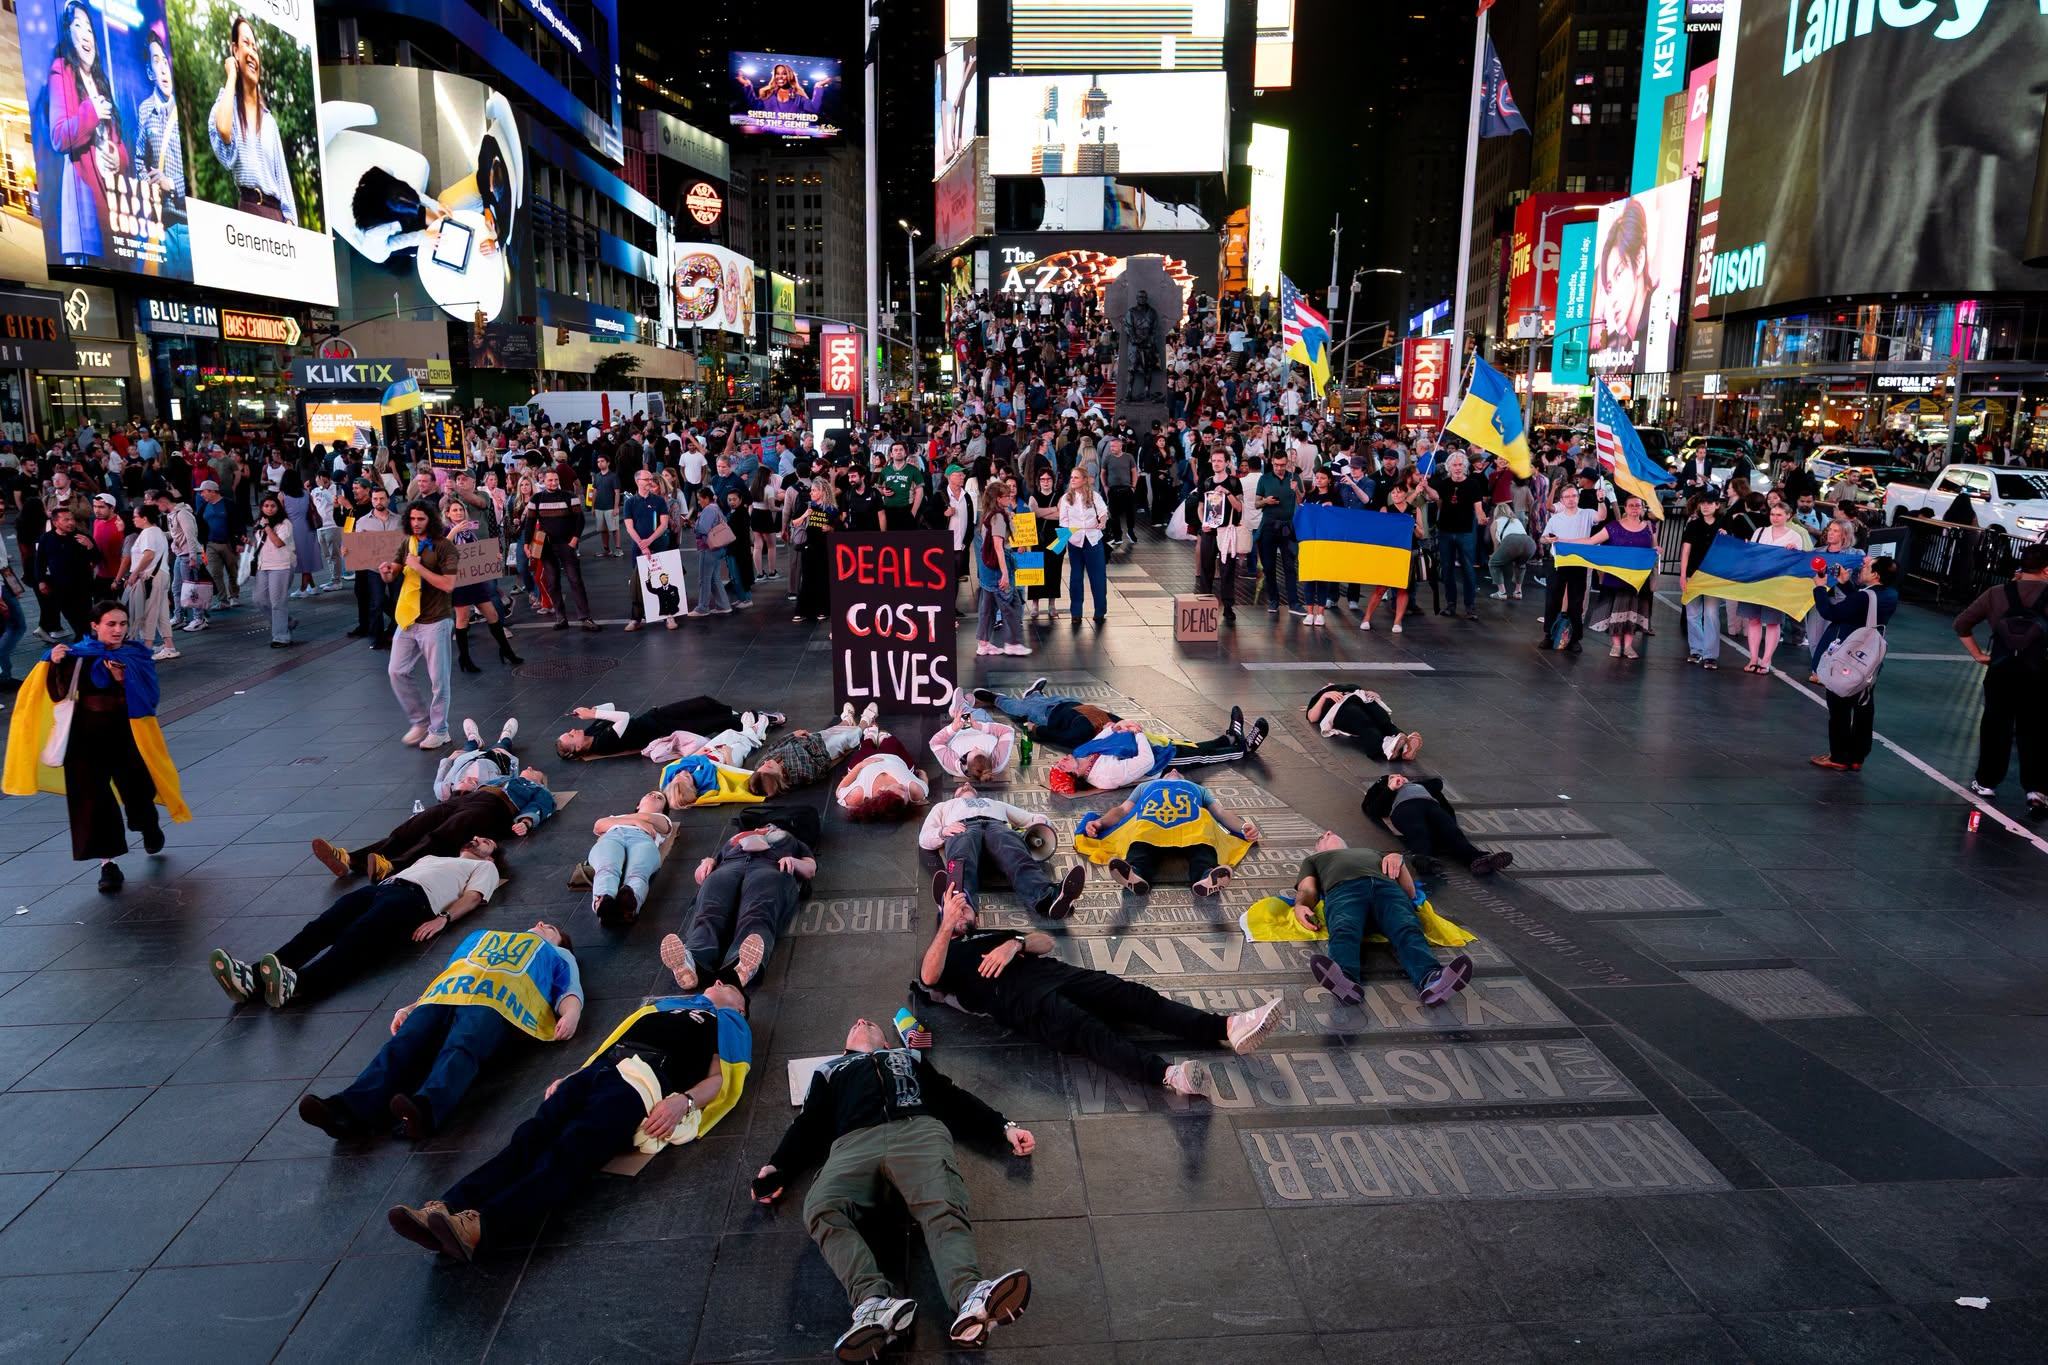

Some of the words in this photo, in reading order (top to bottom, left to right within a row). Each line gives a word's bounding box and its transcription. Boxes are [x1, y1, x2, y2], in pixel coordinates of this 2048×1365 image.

[1692, 4, 1725, 14] BOOS
[1687, 23, 1721, 32] KEVANI
[748, 110, 776, 119] SHERRI
[778, 111, 818, 121] SHEPHERD
[756, 119, 766, 127] IS
[784, 120, 809, 128] GENIE
[673, 136, 695, 152] HYATT
[226, 224, 297, 260] Genentech
[1001, 247, 1036, 263] The
[1700, 234, 1716, 253] NOV
[1512, 243, 1531, 279] FIVE
[1697, 252, 1714, 285] 25
[1710, 242, 1767, 297] ilson
[1001, 267, 1060, 293] A-Z
[149, 300, 189, 323] BLUE
[194, 307, 218, 326] FIN
[225, 315, 246, 337] DOS
[6, 314, 57, 343] GIFTS
[76, 351, 111, 367] YTEA
[831, 337, 856, 391] tkts
[1413, 343, 1441, 400] tkts
[306, 364, 394, 384] KLIKTIX
[407, 368, 428, 379] TICKET
[429, 366, 452, 381] CENTER
[1877, 376, 1920, 387] CENTRAL
[470, 562, 502, 577] BLOOD
[836, 543, 947, 591] DEALS
[846, 602, 942, 644] COST
[1182, 607, 1218, 634] DEALS
[844, 649, 953, 706] LIVES
[1008, 685, 1111, 700] BROADAY
[425, 975, 538, 1031] KRAINE
[1252, 1118, 1718, 1200] NEDERLANDER
